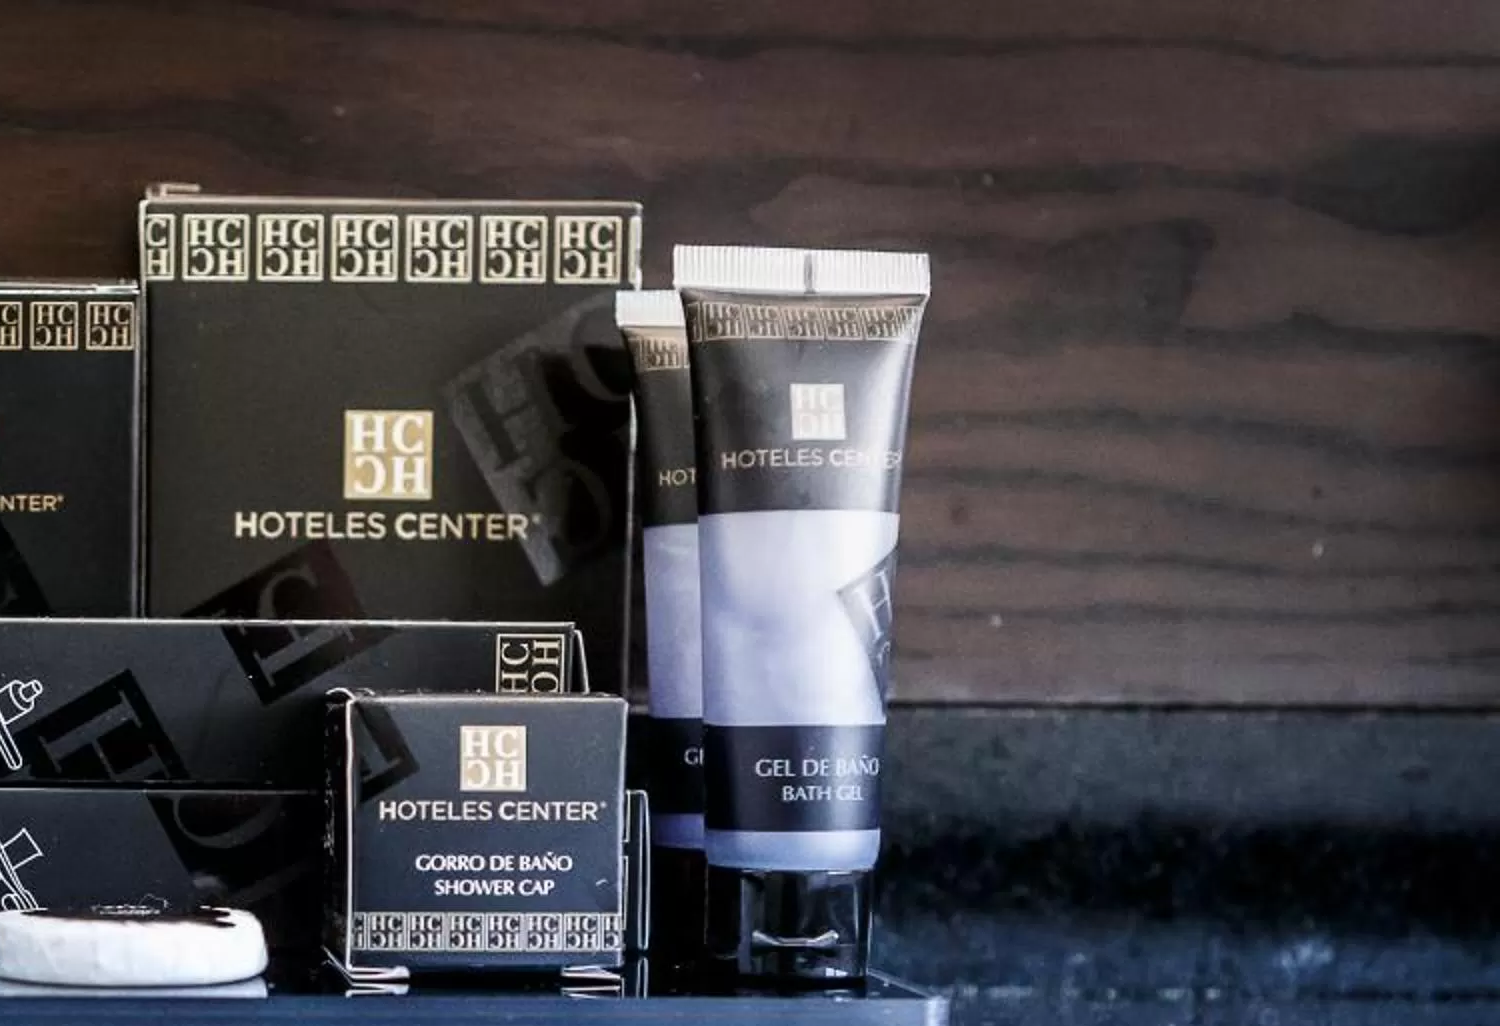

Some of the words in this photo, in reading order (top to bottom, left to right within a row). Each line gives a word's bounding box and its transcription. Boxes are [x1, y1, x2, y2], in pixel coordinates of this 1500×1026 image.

[352, 416, 424, 453] HC
[721, 450, 822, 470] HOTELES
[234, 512, 387, 539] HOTELES
[755, 759, 795, 777] GEL
[802, 759, 829, 777] DE
[783, 786, 831, 801] BATH
[836, 786, 863, 801] GEL
[379, 801, 492, 821] HOTELES
[415, 855, 485, 872] GORRO
[489, 855, 514, 872] DE
[519, 851, 573, 872] BAÑO
[434, 879, 514, 896] SHOWER
[518, 879, 554, 896] CAP
